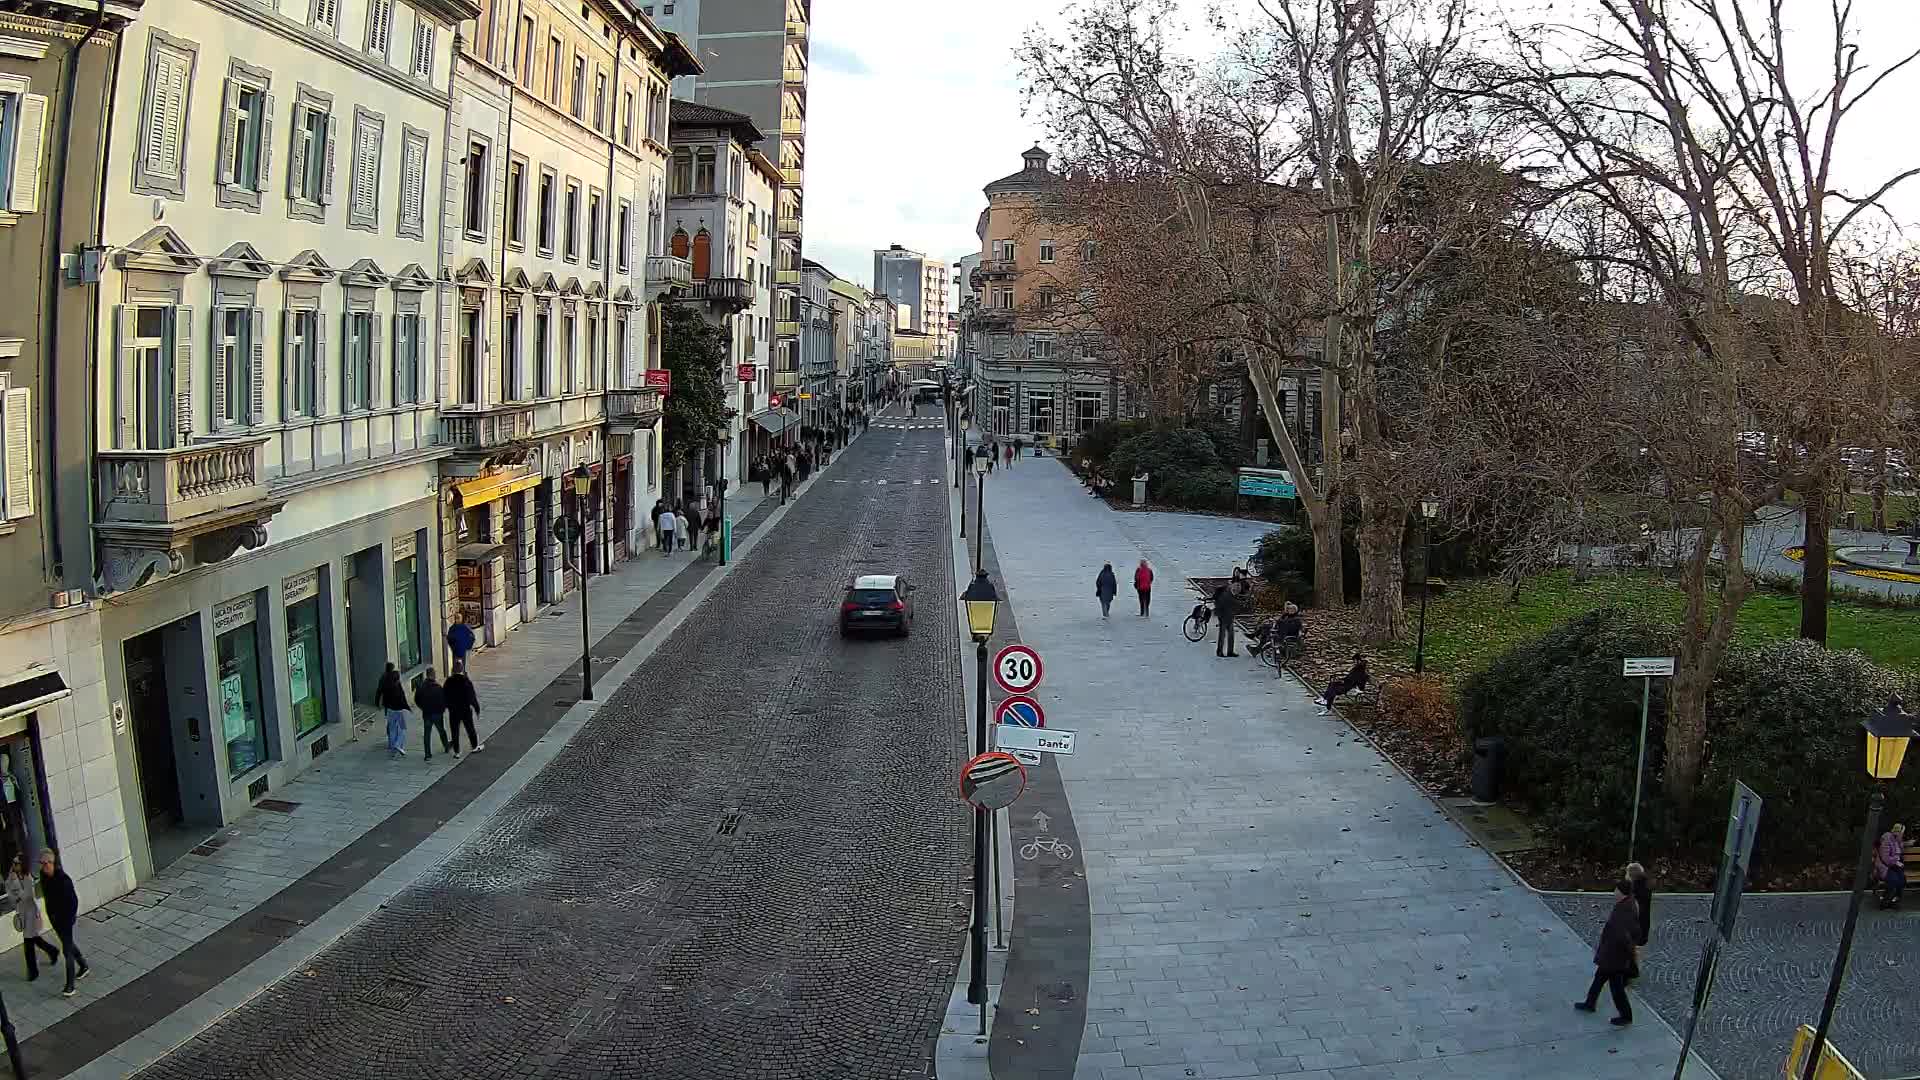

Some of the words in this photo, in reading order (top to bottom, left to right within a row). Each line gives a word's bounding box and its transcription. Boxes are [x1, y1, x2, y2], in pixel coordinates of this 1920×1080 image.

[1005, 658, 1033, 681] 30
[222, 677, 240, 701] 130
[1038, 738, 1070, 749] Dante
